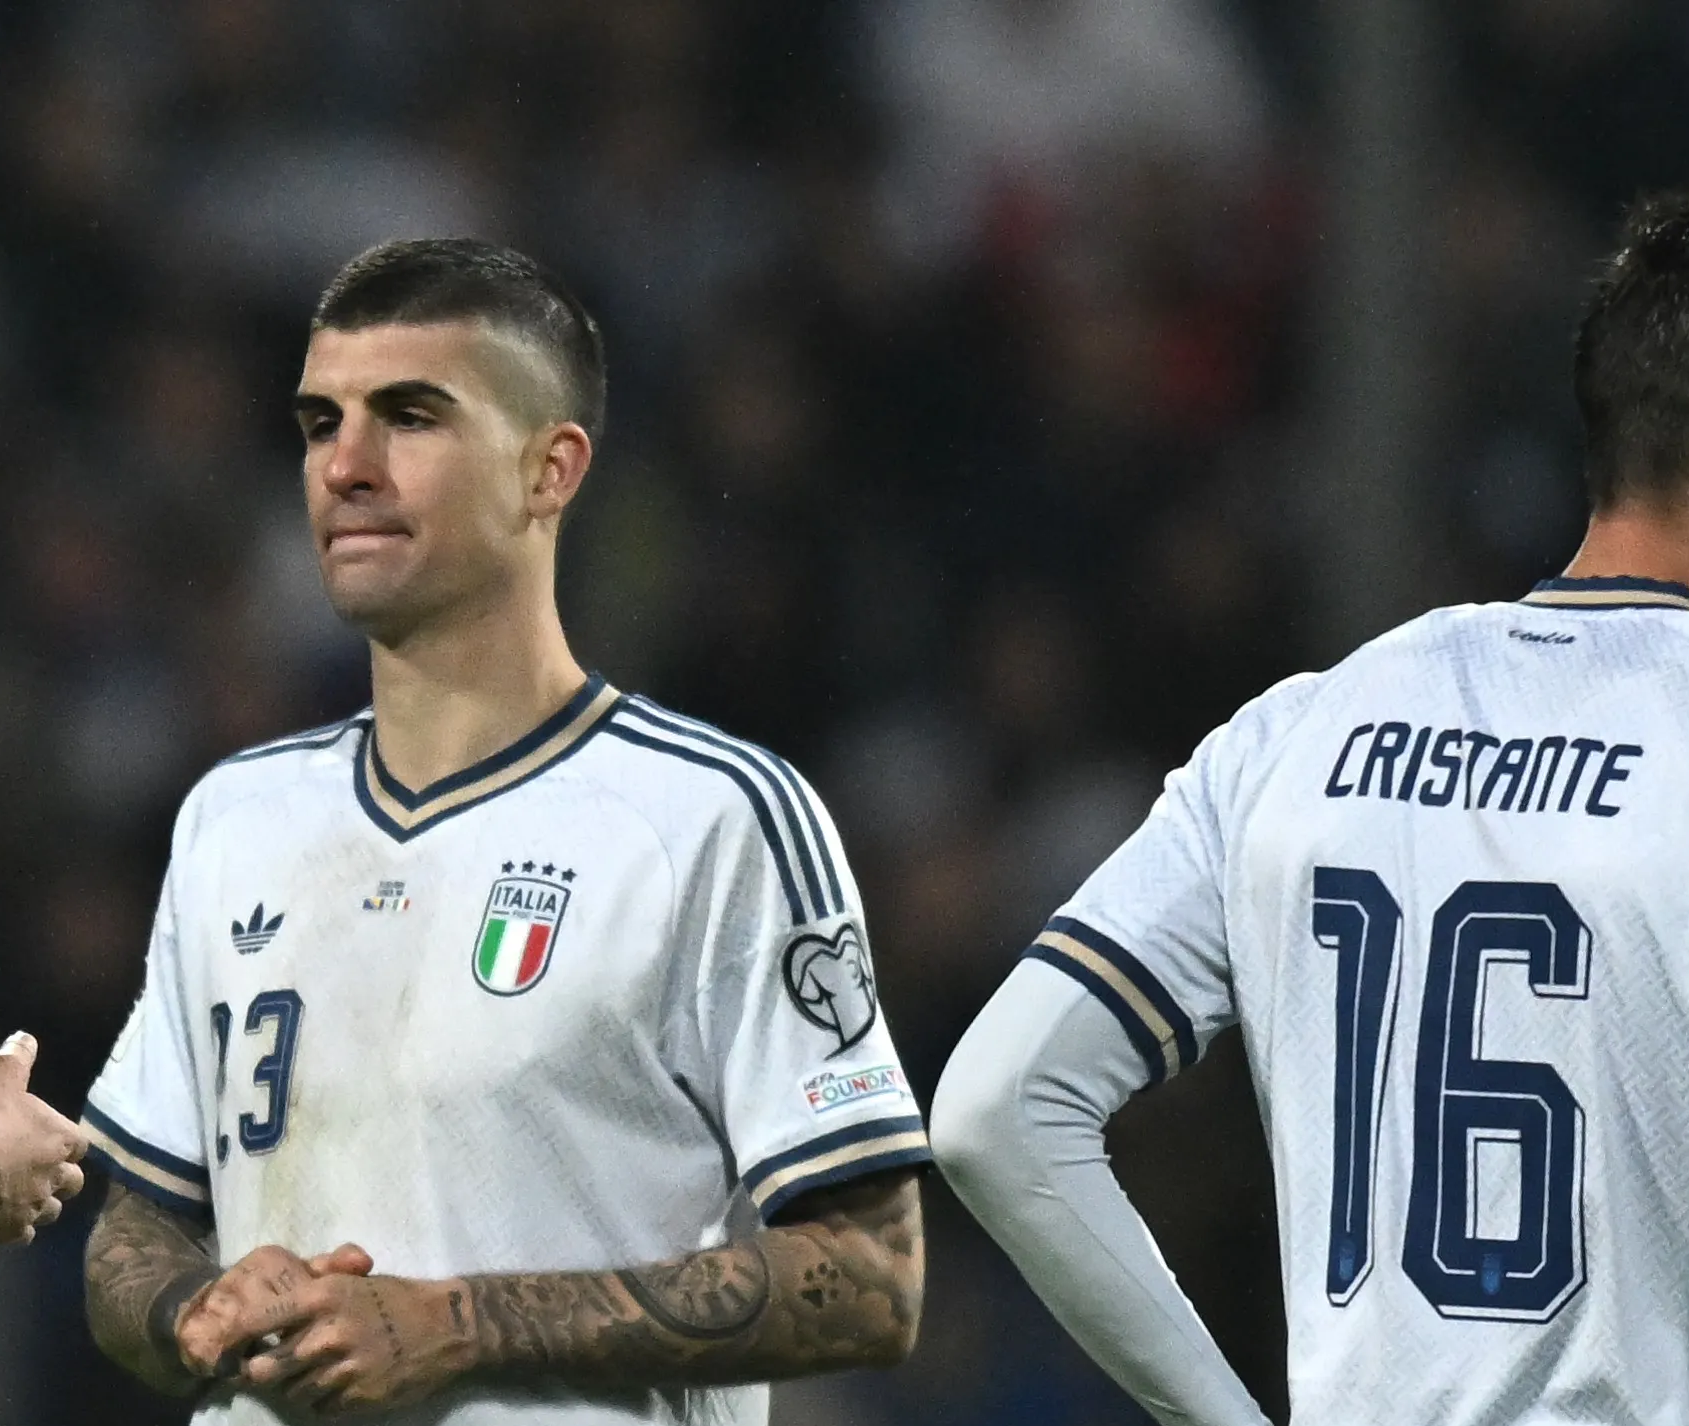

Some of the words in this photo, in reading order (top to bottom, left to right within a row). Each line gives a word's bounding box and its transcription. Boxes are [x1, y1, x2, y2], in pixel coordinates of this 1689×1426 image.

[1324, 721, 1644, 817] CRISTANTE
[494, 886, 557, 914] ITALIA
[1313, 867, 1592, 1324] 16
